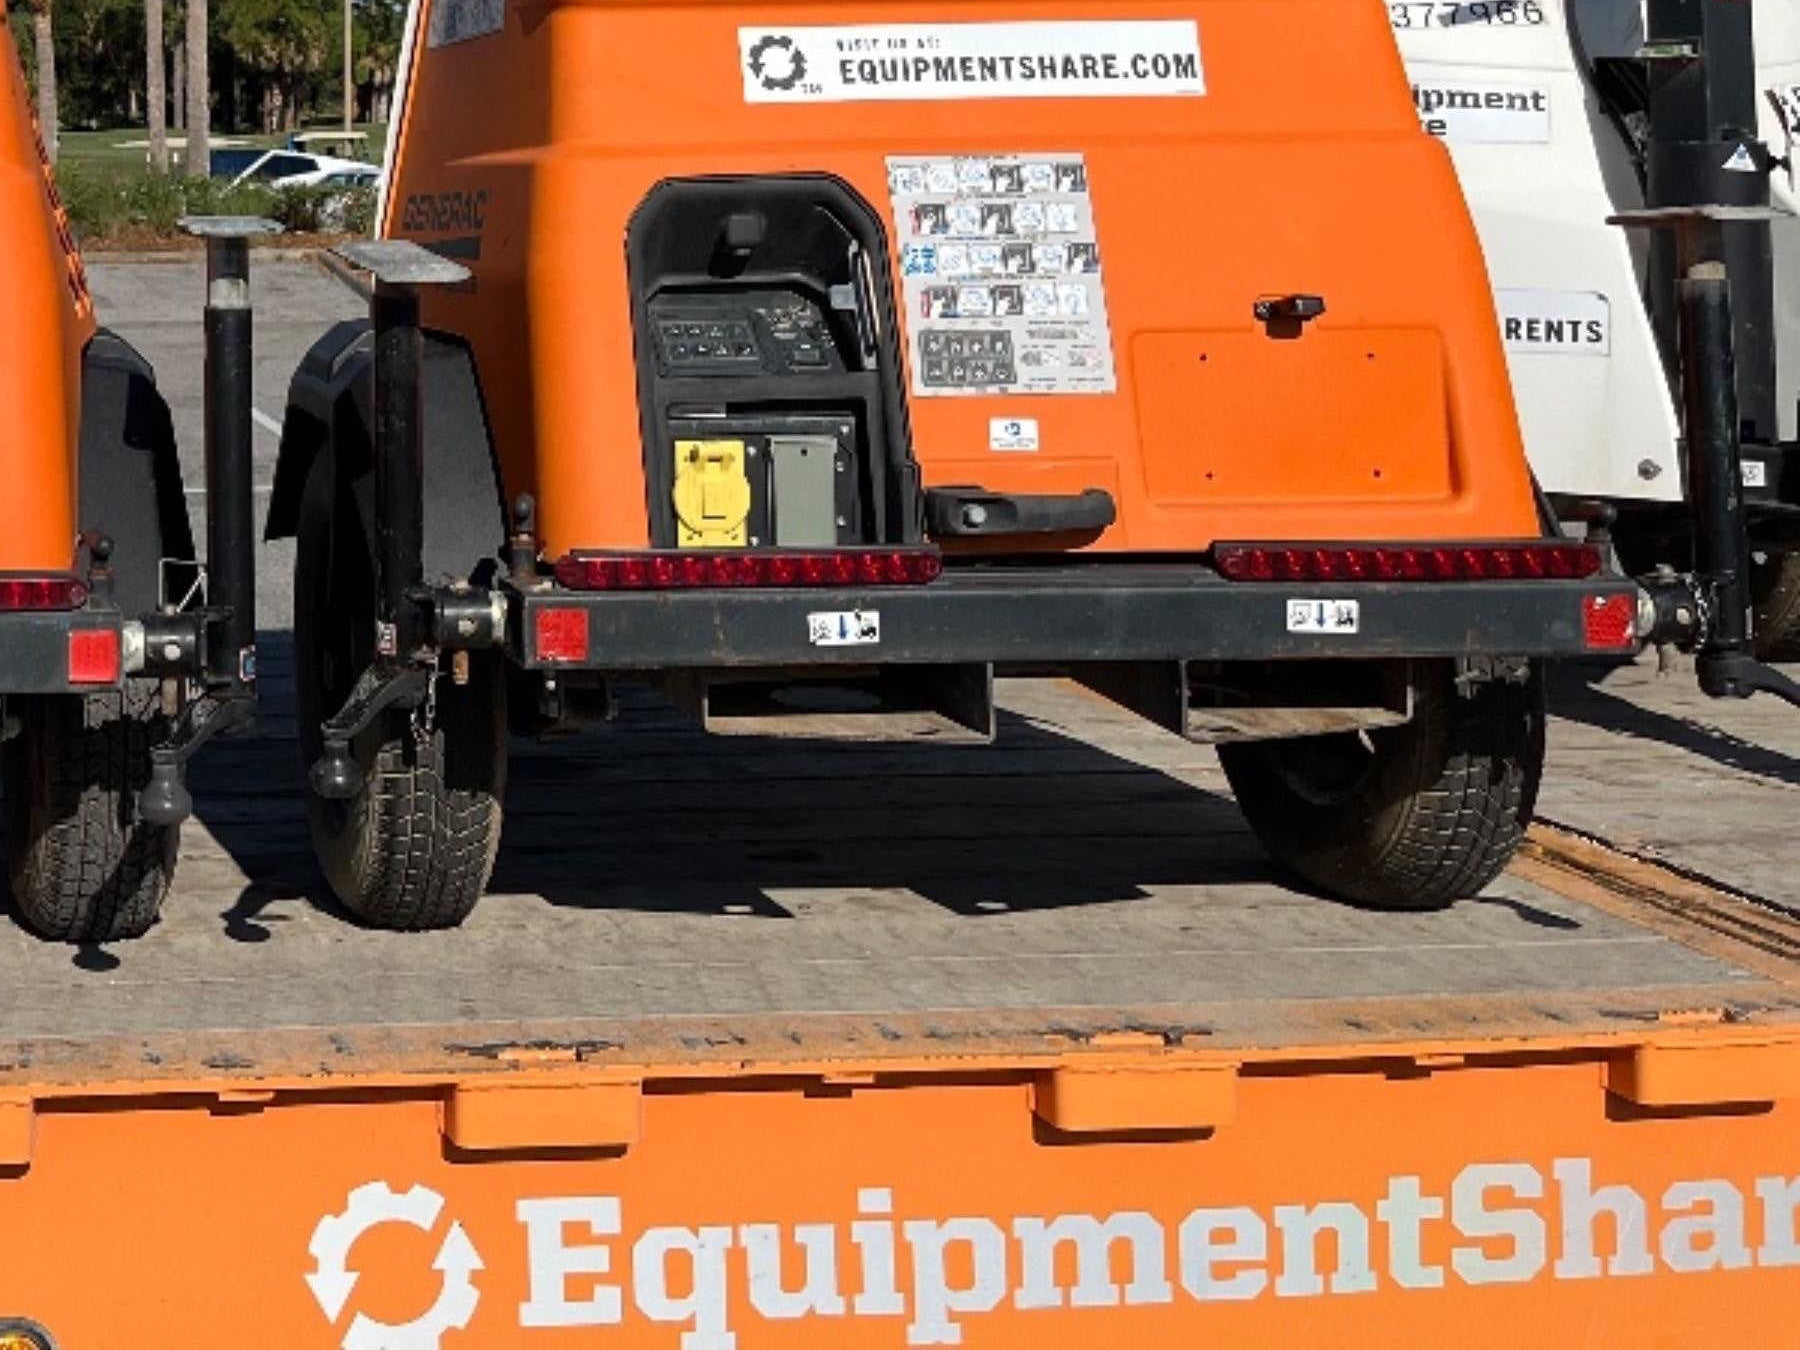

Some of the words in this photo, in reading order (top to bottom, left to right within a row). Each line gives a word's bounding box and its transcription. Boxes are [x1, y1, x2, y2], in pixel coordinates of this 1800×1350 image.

[1390, 0, 1545, 28] 377966
[838, 52, 1198, 85] EQUIPMENTSHARE.COM
[1505, 317, 1603, 343] RENTS
[516, 1158, 1800, 1348] EquipmentShar
